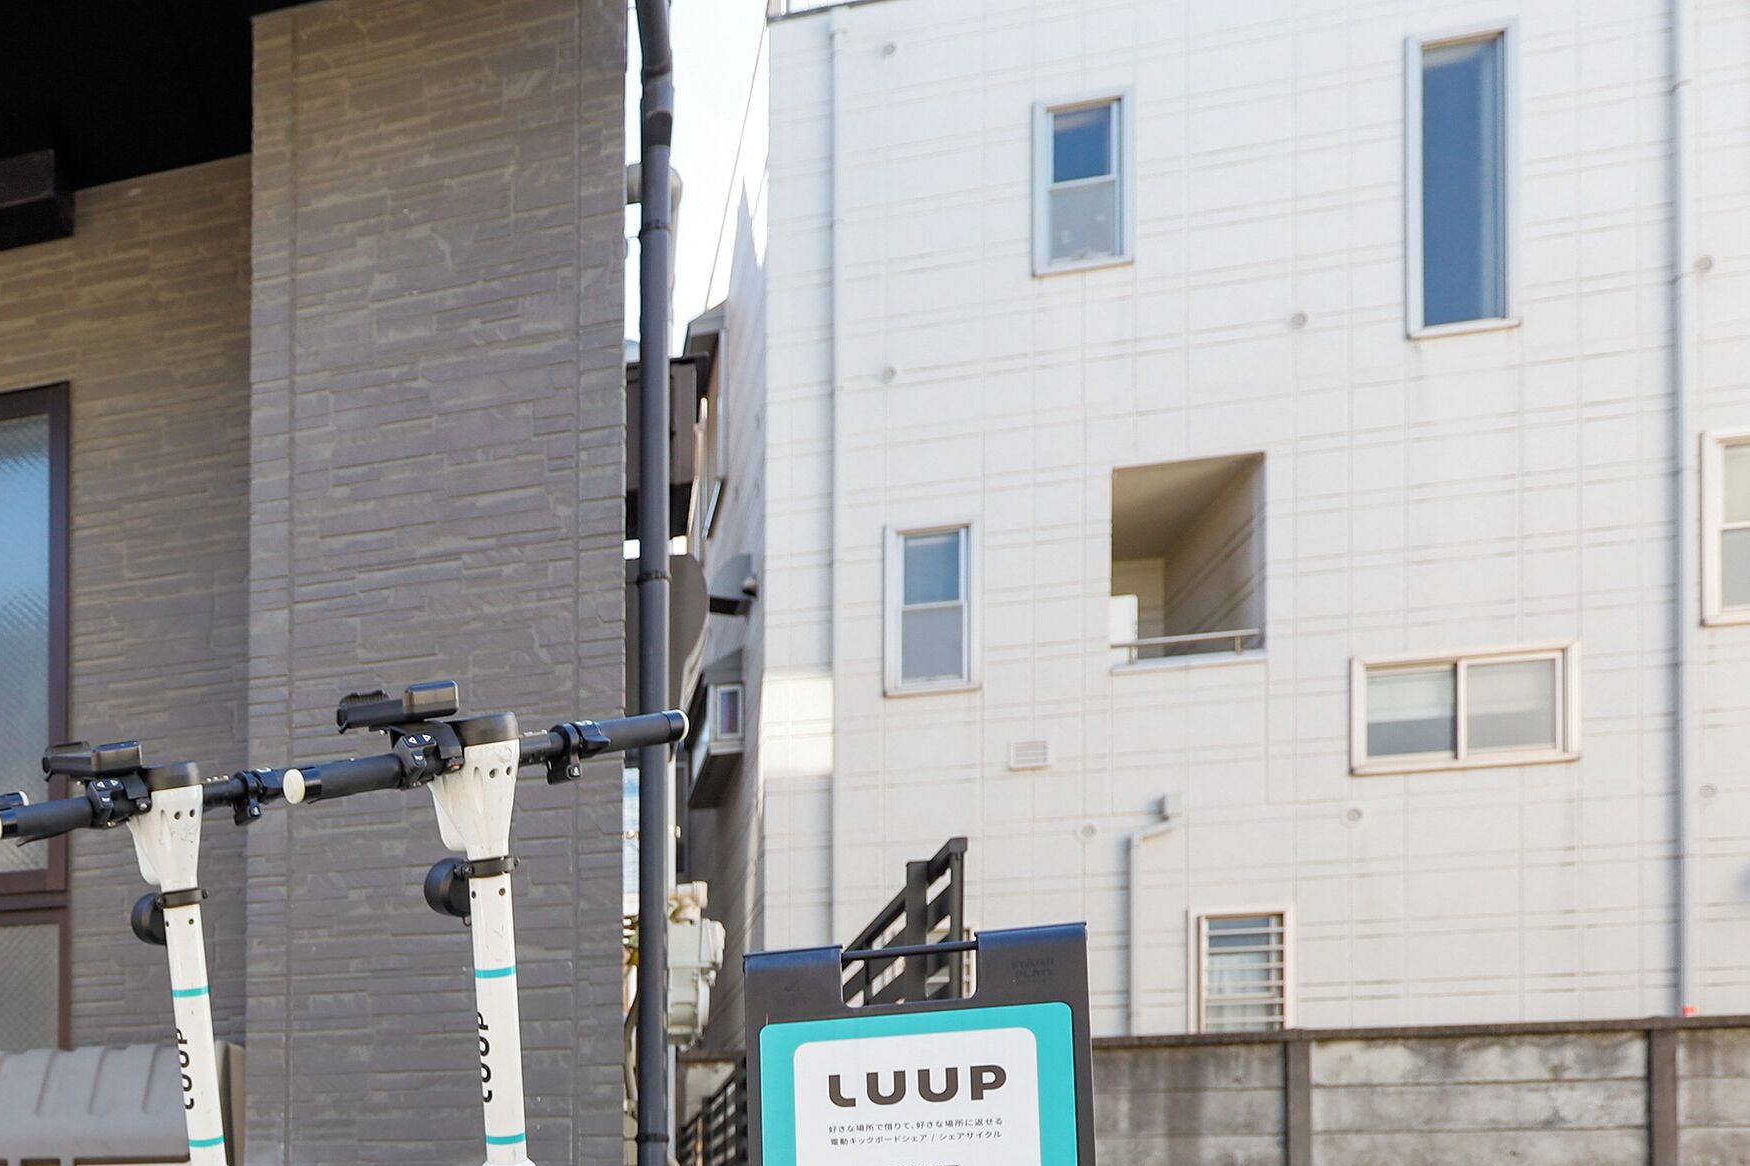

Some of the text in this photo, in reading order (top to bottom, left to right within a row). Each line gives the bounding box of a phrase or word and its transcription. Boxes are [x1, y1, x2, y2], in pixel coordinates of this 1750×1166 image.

[828, 1064, 1007, 1107] LUUP
[828, 1117, 1003, 1134] 好きな場所で借りて、好きな場所に返せる
[830, 1133, 928, 1146] 電動キックボードシェア
[939, 1130, 1002, 1142] シェアサイクル
